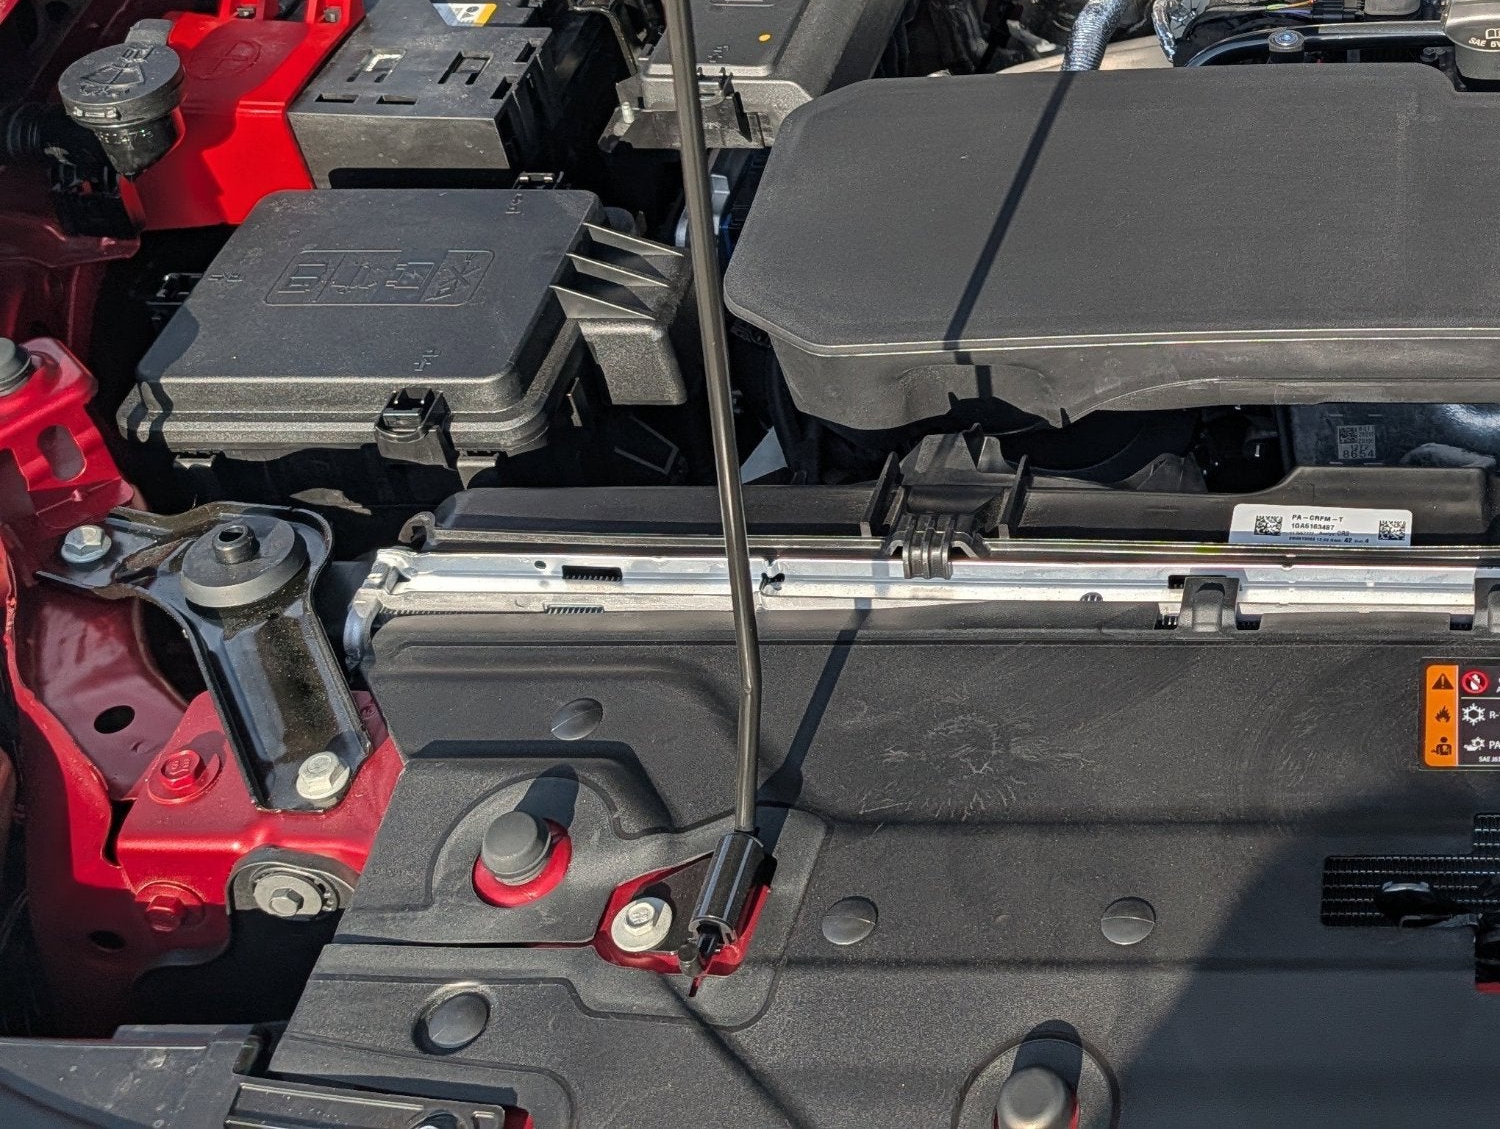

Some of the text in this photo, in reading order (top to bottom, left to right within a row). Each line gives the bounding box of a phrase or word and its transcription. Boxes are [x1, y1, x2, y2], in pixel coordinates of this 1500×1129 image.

[1468, 36, 1487, 47] SAE
[1343, 450, 1375, 459] 8654
[1478, 755, 1491, 763] SAE
